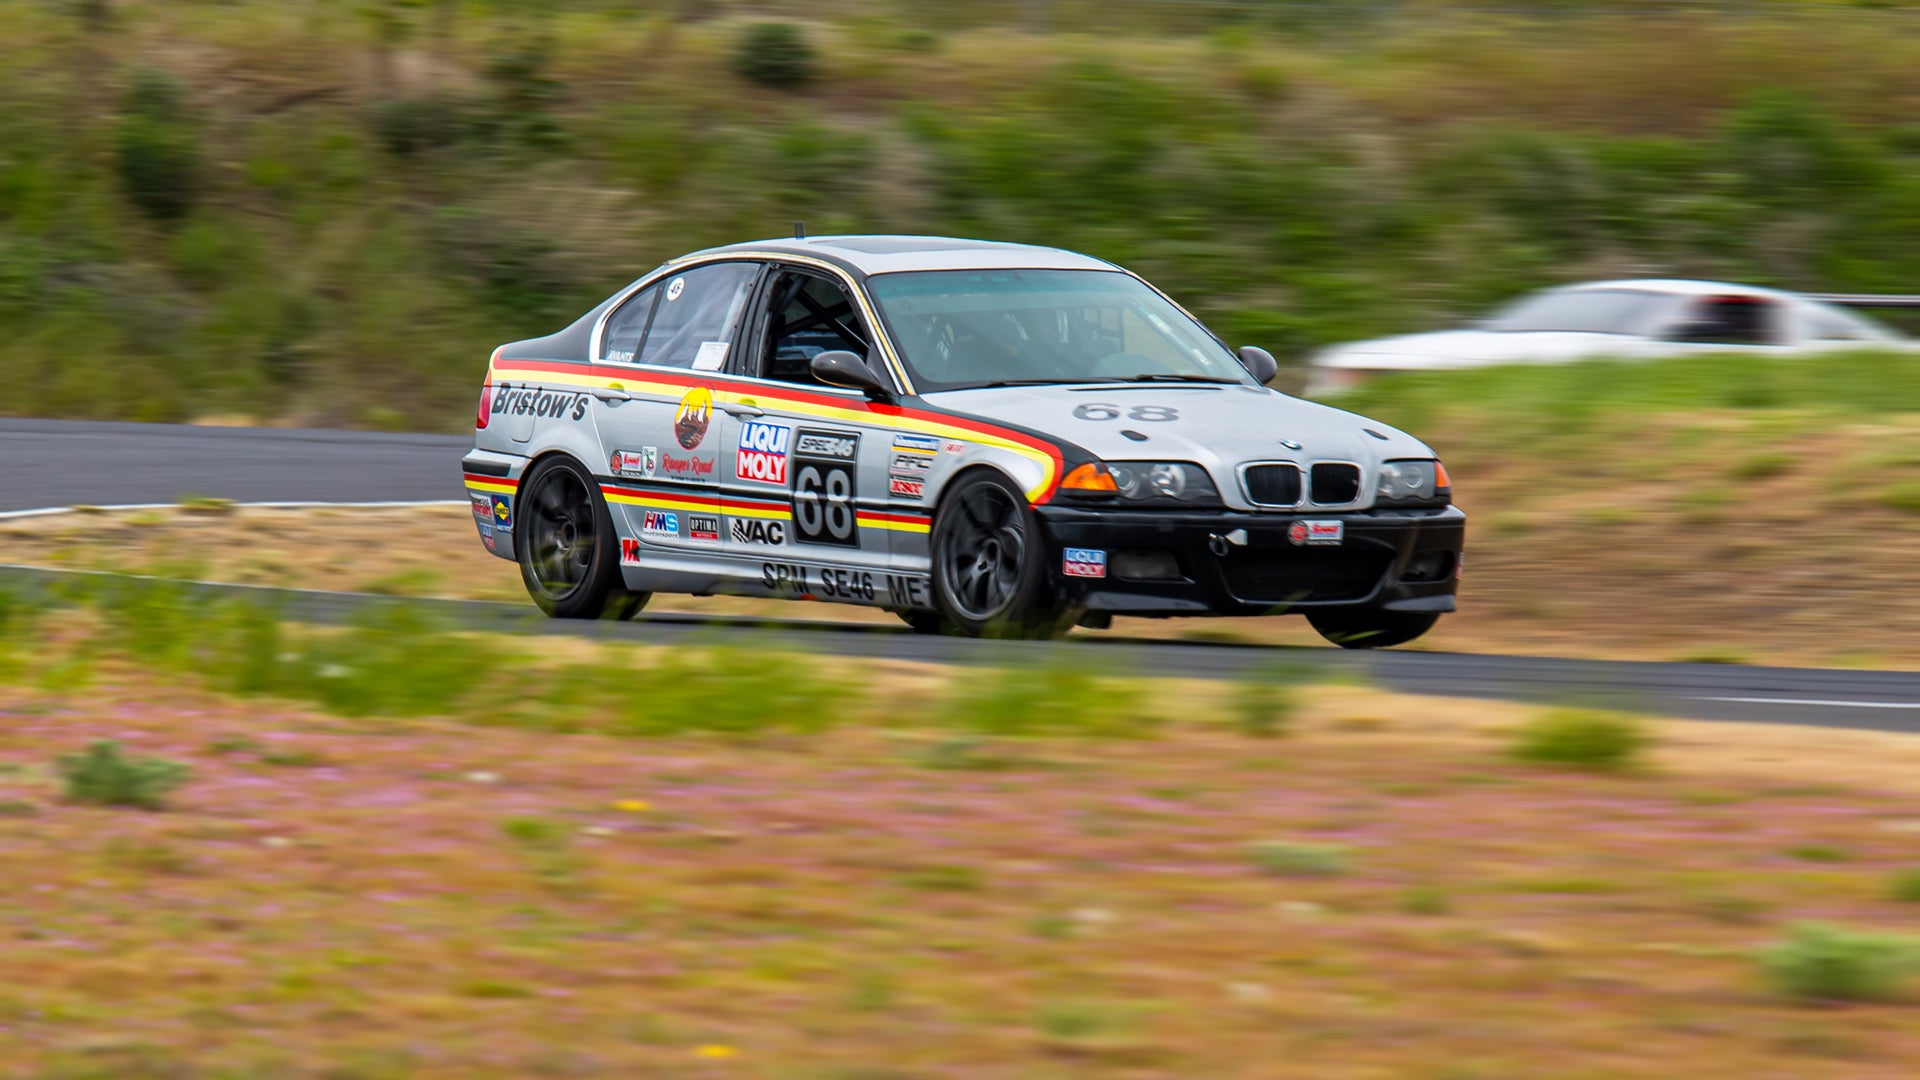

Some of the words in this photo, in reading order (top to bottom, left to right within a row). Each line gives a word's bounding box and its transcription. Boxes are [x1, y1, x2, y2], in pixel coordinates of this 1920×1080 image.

[491, 382, 589, 422] Bristow's
[1072, 402, 1180, 423] 68
[740, 422, 790, 453] LIQUI
[662, 452, 690, 474] Ranger
[692, 456, 715, 476] Road
[738, 451, 785, 482] MOLY
[794, 465, 852, 540] 68
[643, 511, 680, 533] HMS
[690, 516, 718, 532] OPTIMA
[731, 518, 784, 545] VAC
[762, 562, 811, 595] SPM
[821, 568, 875, 601] SE46
